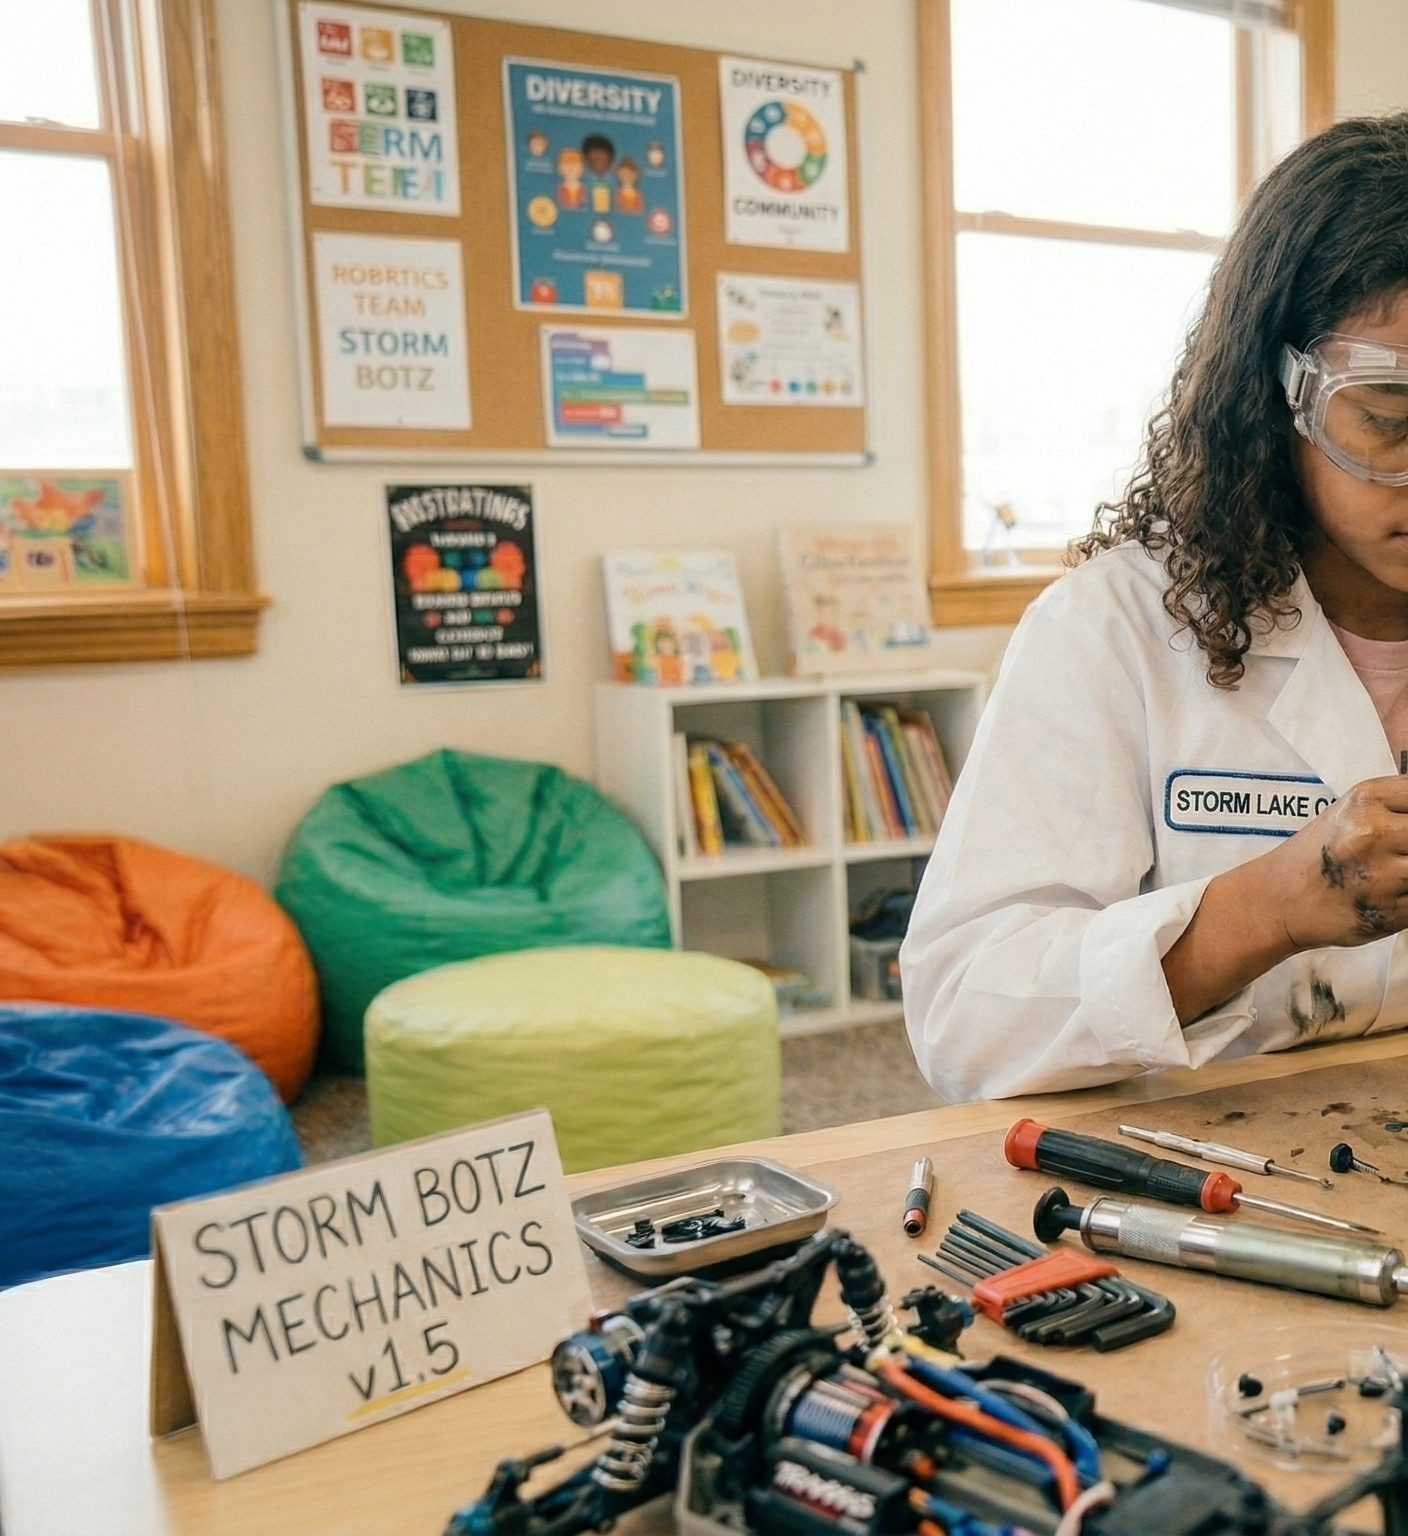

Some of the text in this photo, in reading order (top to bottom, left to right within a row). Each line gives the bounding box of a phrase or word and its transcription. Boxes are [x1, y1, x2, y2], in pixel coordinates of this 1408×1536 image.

[526, 74, 662, 114] DIVERSITY
[354, 293, 426, 316] TEAM
[340, 327, 449, 356] STORM
[356, 364, 435, 391] BOTZ
[1177, 789, 1250, 813] STORM
[1257, 794, 1309, 817] LAKE
[194, 1140, 545, 1288] STORM BOTZ
[222, 1220, 553, 1374] MECHANICS
[349, 1321, 460, 1400] v1.5
